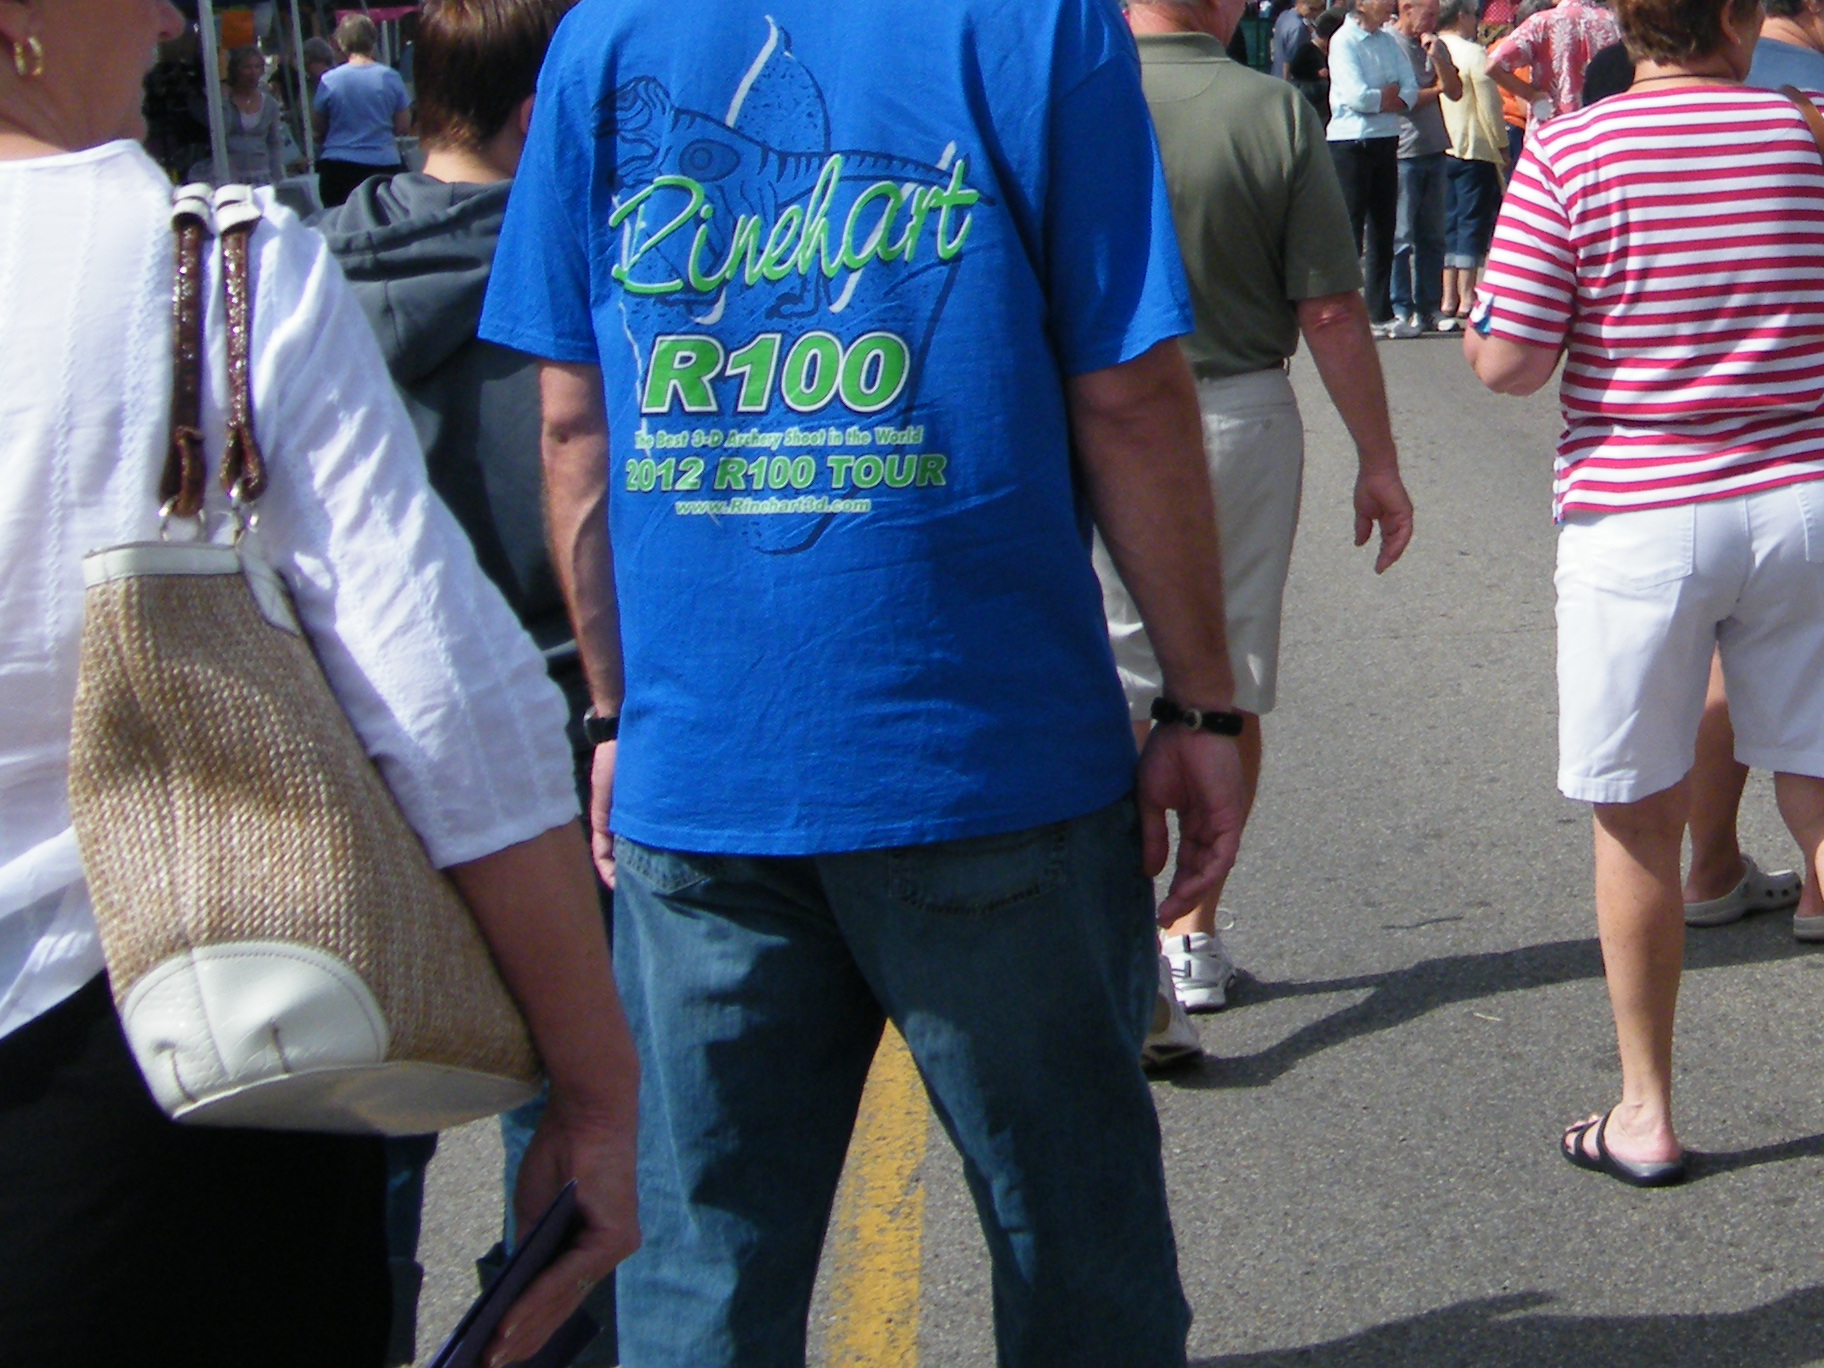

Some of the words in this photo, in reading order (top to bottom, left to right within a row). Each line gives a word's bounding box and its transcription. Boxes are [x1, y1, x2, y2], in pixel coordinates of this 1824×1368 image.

[609, 153, 980, 294] Rinehart
[640, 330, 912, 414] R100
[655, 429, 690, 450] Best
[691, 428, 724, 448] 3-D
[723, 427, 784, 451] Archery
[783, 426, 826, 447] Shoot
[827, 426, 844, 446] in
[845, 425, 873, 446] the
[874, 425, 924, 445] World
[625, 456, 705, 493] 2012
[713, 455, 817, 491] R100
[826, 453, 948, 489] TOUR
[674, 494, 872, 516] www.Rinehart3d.com
